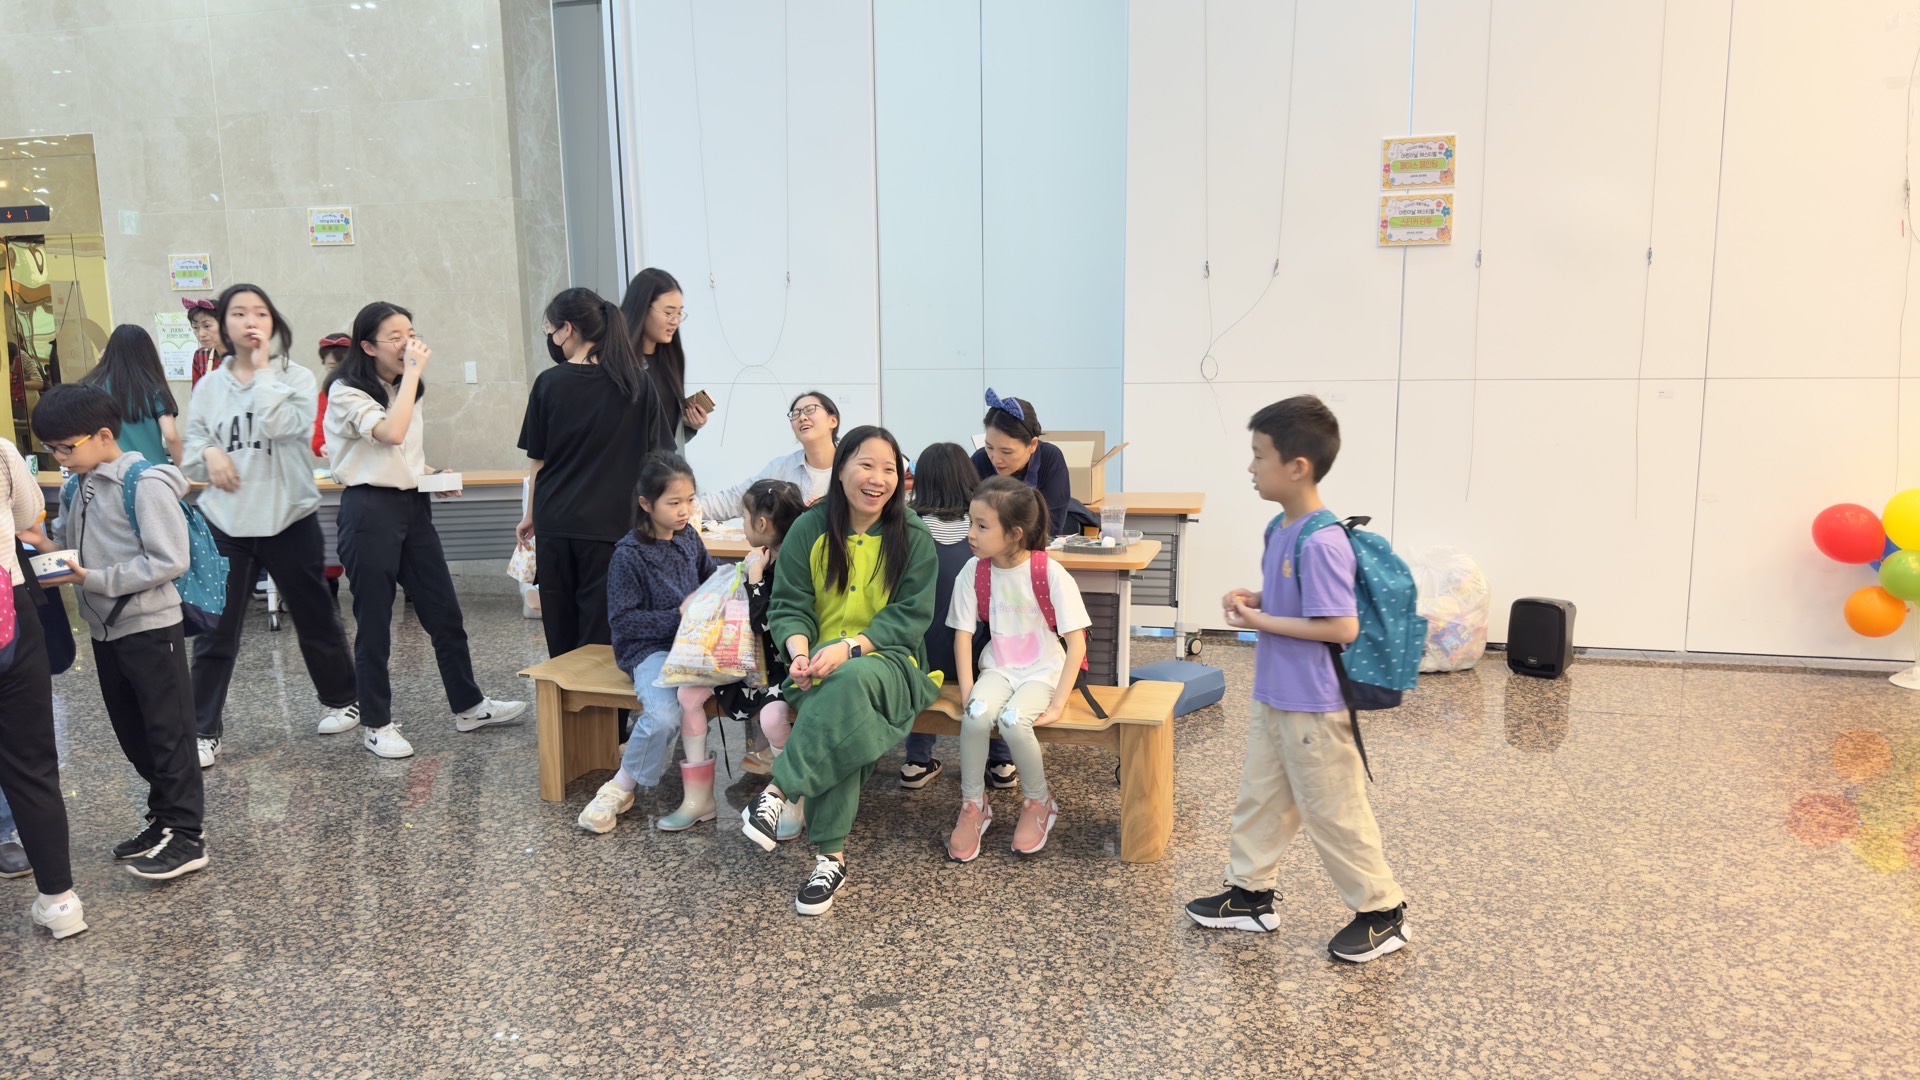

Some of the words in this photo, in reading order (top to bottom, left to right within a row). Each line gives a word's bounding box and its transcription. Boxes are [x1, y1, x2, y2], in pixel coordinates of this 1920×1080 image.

[1400, 160, 1418, 169] 페이스
[1419, 159, 1438, 169] 페인팅
[25, 209, 29, 220] 1
[1400, 217, 1418, 226] 스티커
